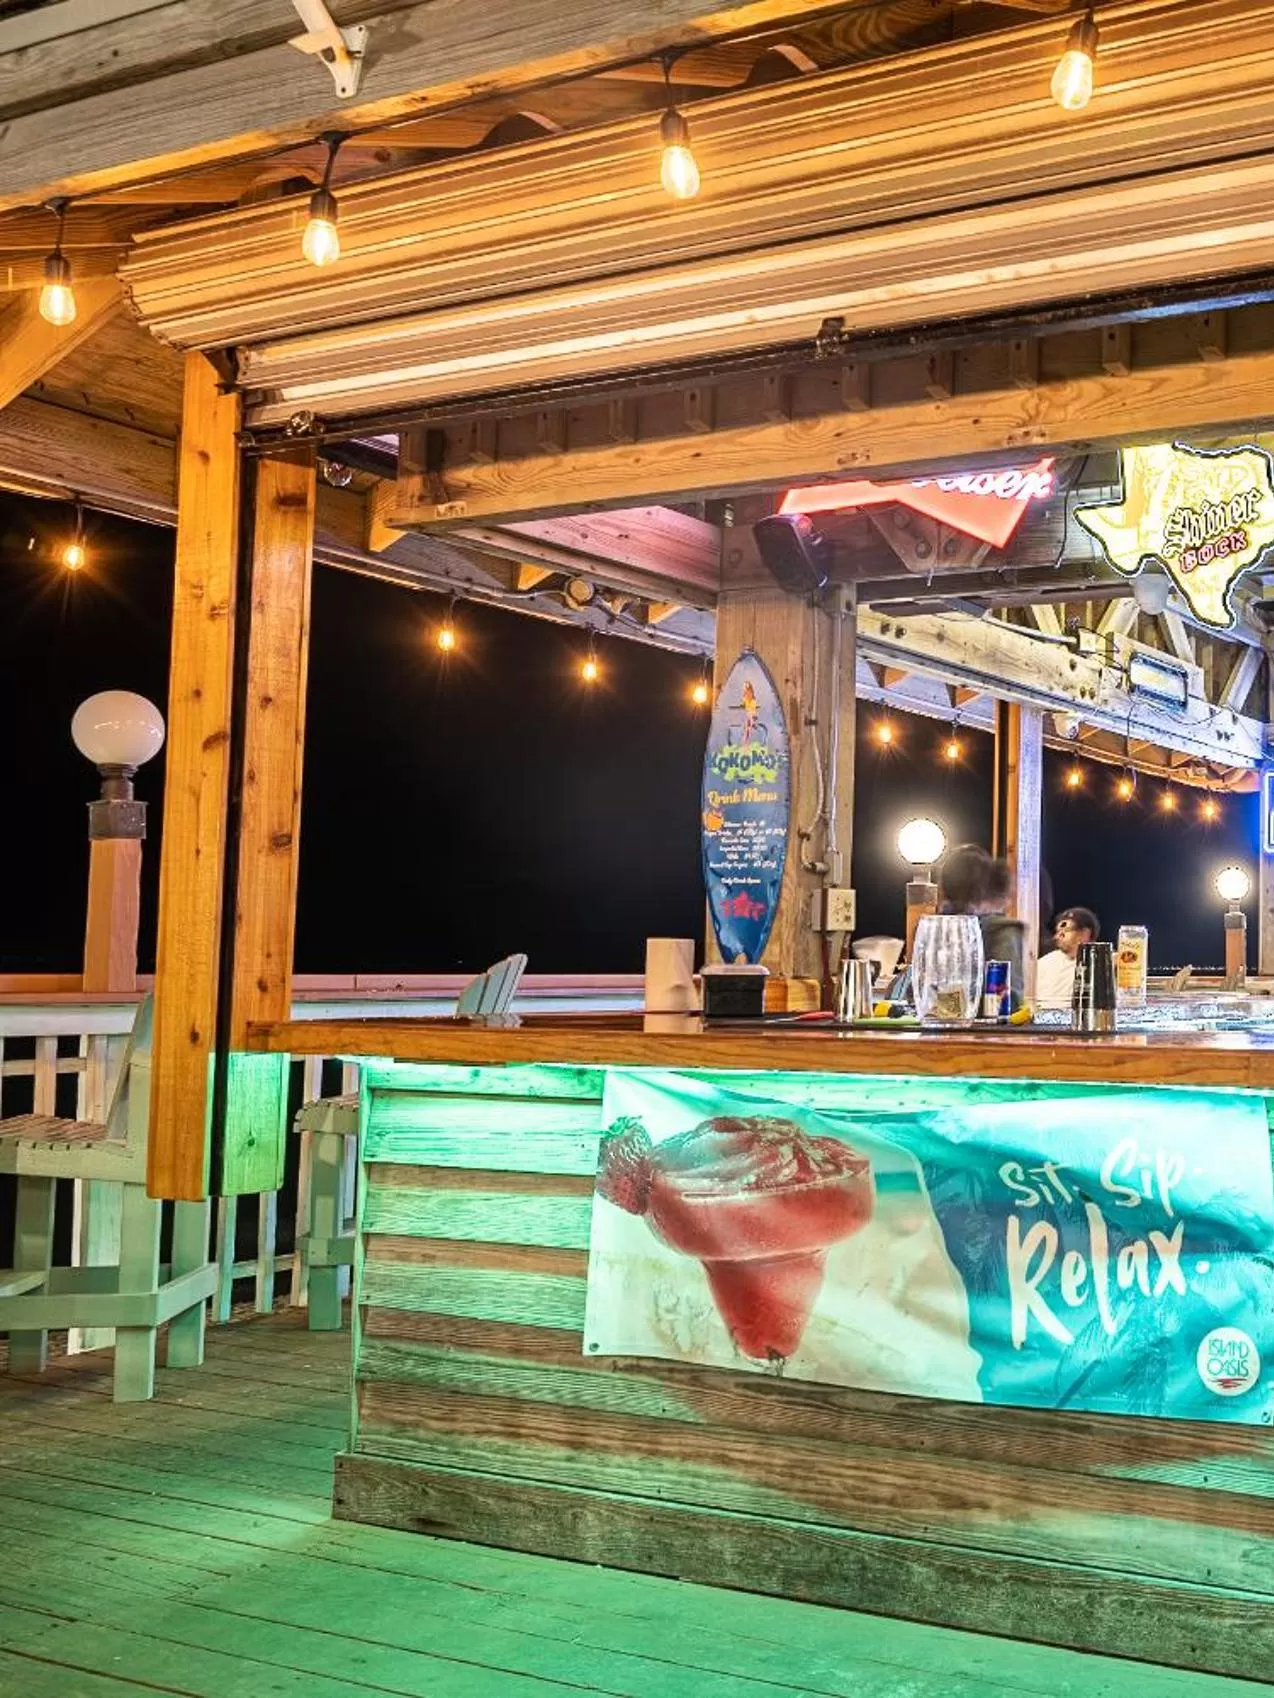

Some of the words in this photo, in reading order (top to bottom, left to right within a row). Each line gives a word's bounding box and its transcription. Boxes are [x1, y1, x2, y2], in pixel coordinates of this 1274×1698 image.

[1162, 487, 1264, 559] Shiner
[1179, 530, 1248, 573] BOCK
[1208, 1338, 1250, 1359] ISLAND
[1207, 1358, 1249, 1378] OASIS
